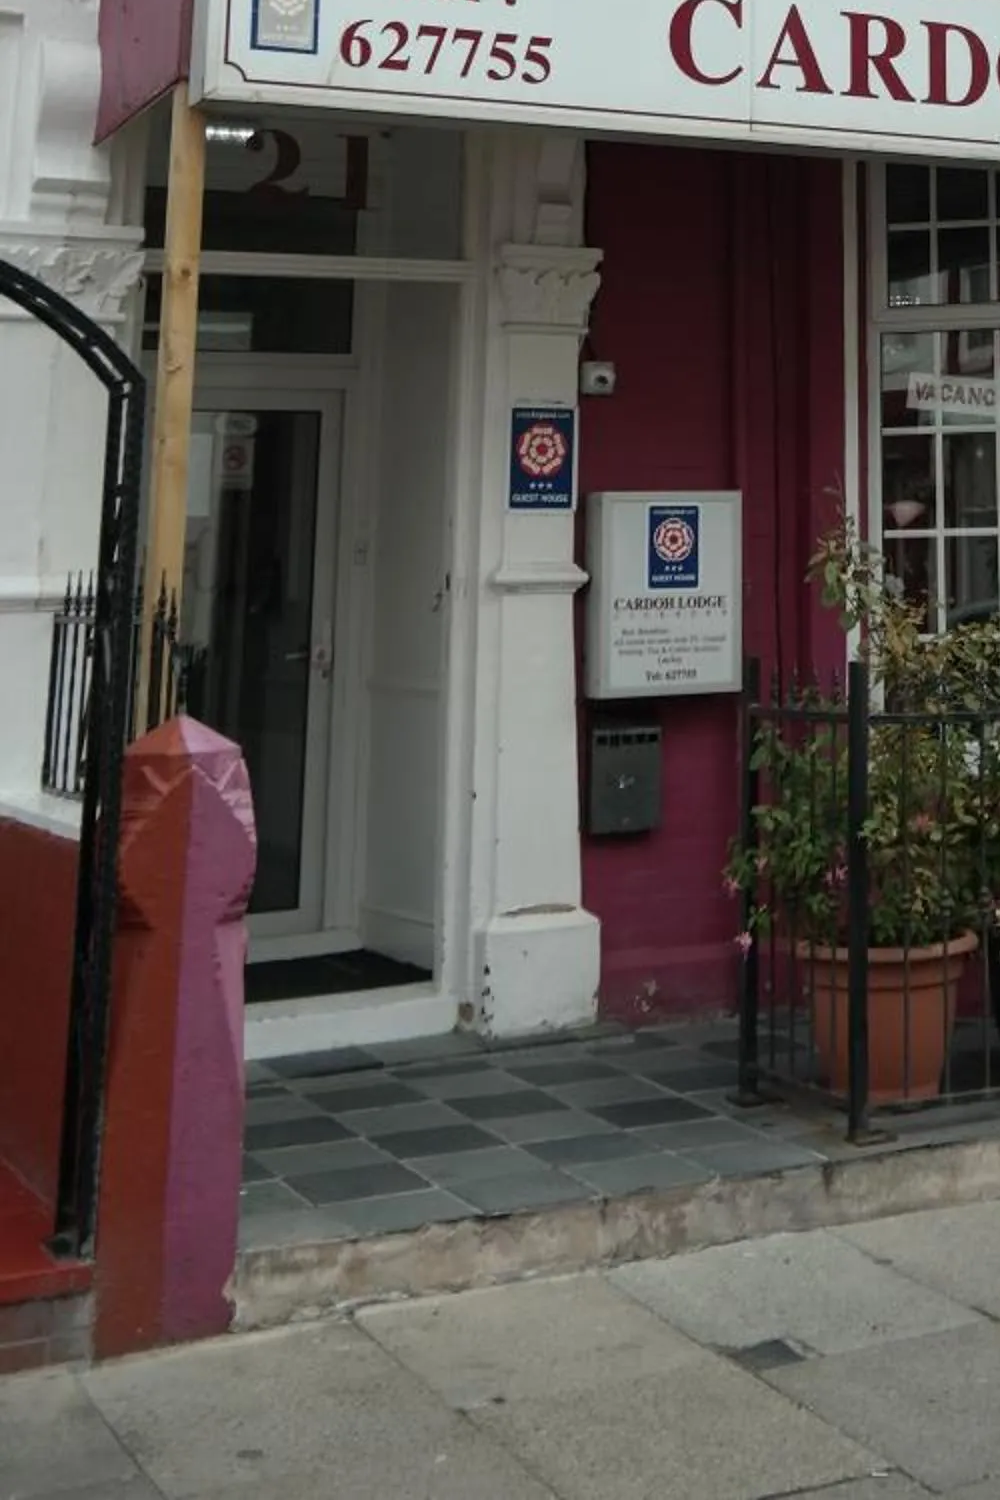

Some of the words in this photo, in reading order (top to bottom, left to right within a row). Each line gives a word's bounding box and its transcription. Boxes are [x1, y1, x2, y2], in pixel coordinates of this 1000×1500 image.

[339, 19, 553, 85] 627755
[246, 128, 382, 214] 21
[613, 596, 676, 611] CARDOH
[677, 595, 728, 610] LODGE
